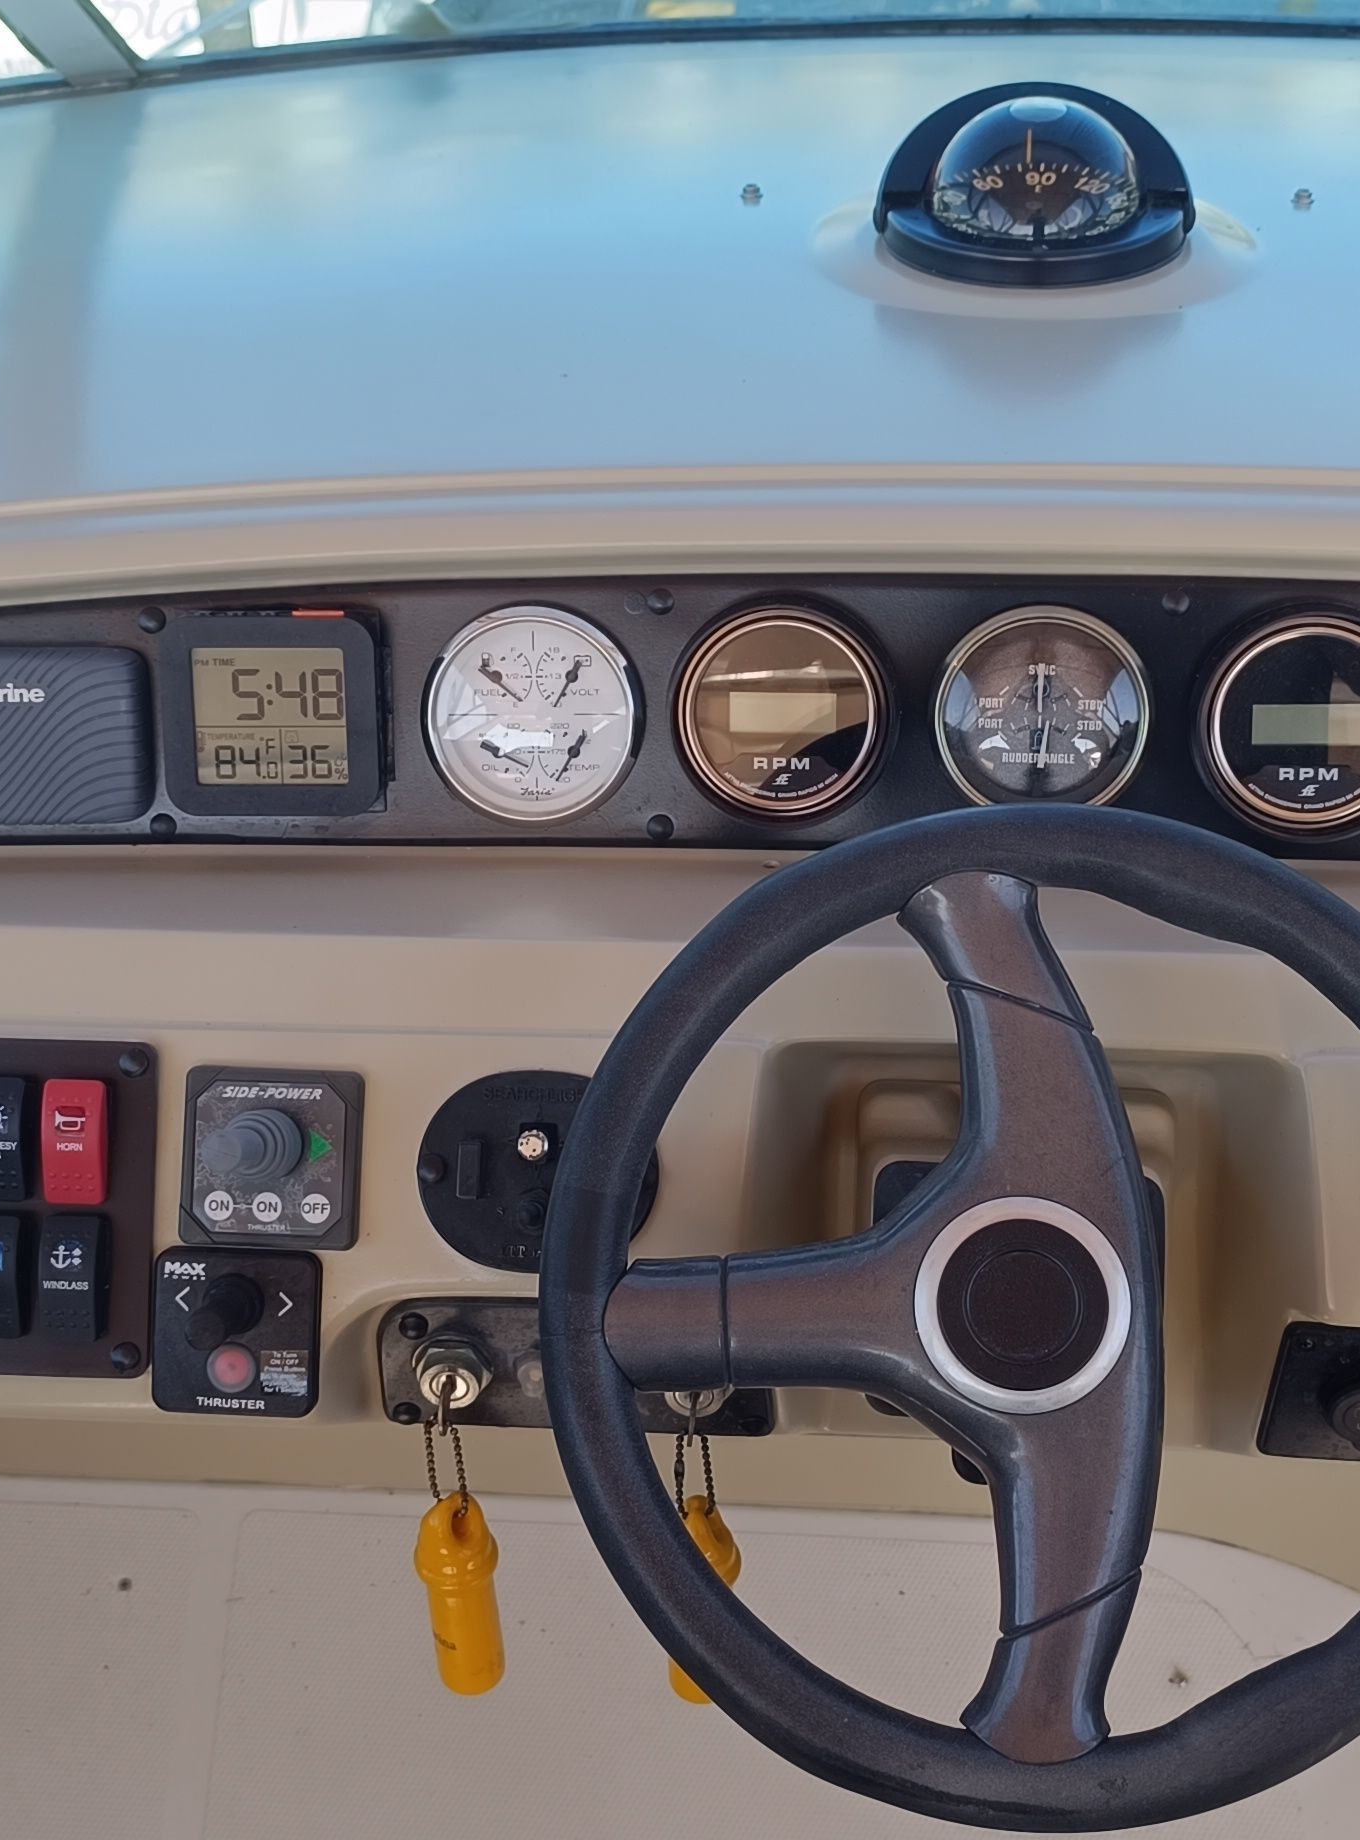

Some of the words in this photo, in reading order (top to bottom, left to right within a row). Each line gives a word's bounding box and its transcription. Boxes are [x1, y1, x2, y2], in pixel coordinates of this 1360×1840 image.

[1025, 171, 1057, 187] 90
[1073, 175, 1110, 195] 120
[212, 658, 236, 667] TIME
[231, 668, 344, 721] 5:48
[978, 697, 1005, 709] PORT
[1077, 699, 1103, 711] STBD
[977, 717, 1003, 729] PORT
[1076, 720, 1103, 731] STBD
[207, 732, 256, 741] TEMPERATURE
[753, 757, 811, 770] RPM
[1044, 752, 1076, 764] ANGLE
[1278, 767, 1339, 781] RPM
[221, 1085, 323, 1100] SIDE-POWER
[56, 1142, 83, 1152] HORN
[208, 1199, 230, 1212] ON
[256, 1200, 279, 1214] ON
[301, 1202, 331, 1215] OFF
[247, 1223, 286, 1232] THRUSTER
[164, 1261, 207, 1276] MAX
[42, 1280, 89, 1291] WINDLASS
[196, 1396, 265, 1410] THRUSTER
